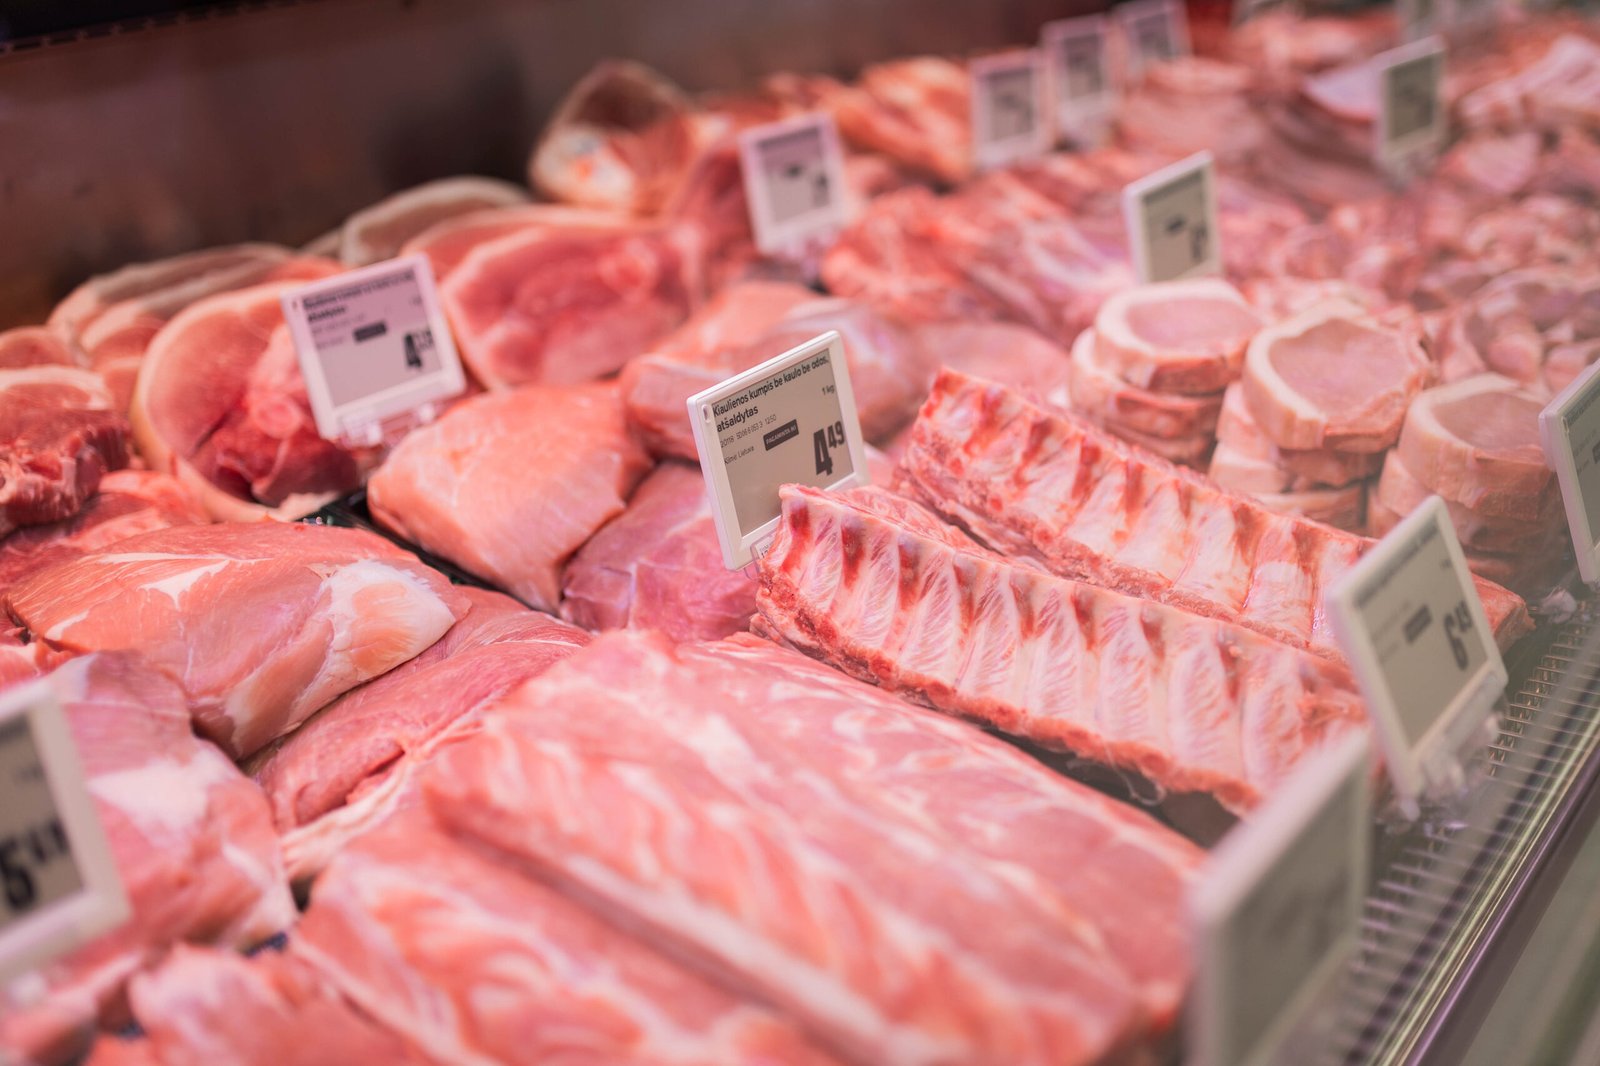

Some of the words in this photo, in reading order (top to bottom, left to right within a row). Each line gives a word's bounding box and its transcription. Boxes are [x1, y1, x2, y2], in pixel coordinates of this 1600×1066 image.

[713, 395, 749, 417] Kiaulienos
[748, 381, 774, 400] kumpis
[773, 377, 784, 388] be
[782, 367, 802, 383] kaulo
[801, 363, 812, 375] be
[716, 405, 759, 433] atšaldytas
